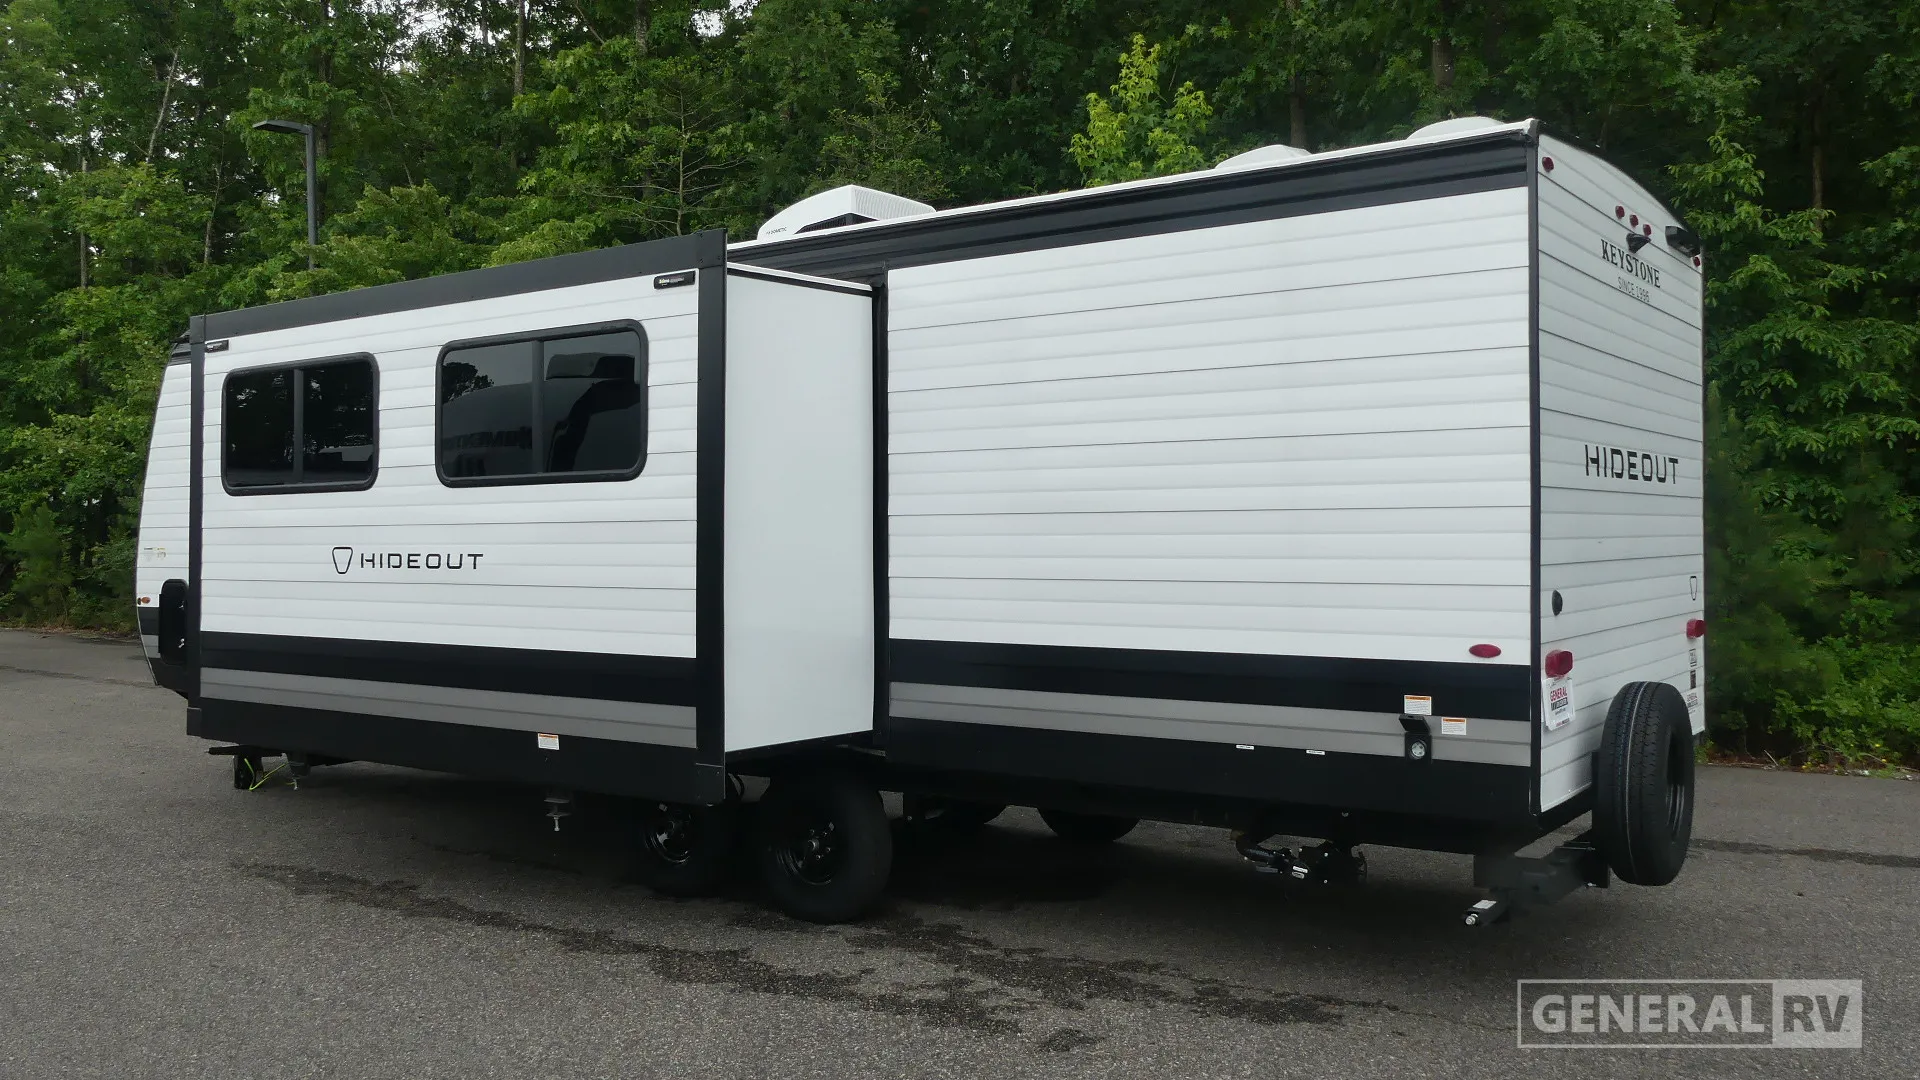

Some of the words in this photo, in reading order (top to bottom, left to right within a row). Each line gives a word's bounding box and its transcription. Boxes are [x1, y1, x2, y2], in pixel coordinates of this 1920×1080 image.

[1601, 239, 1660, 288] KEYSTONE
[1617, 276, 1635, 296] SINCE
[1635, 285, 1650, 303] 1996
[1585, 444, 1679, 485] HIDEOUT
[360, 552, 484, 570] HIDEOUT
